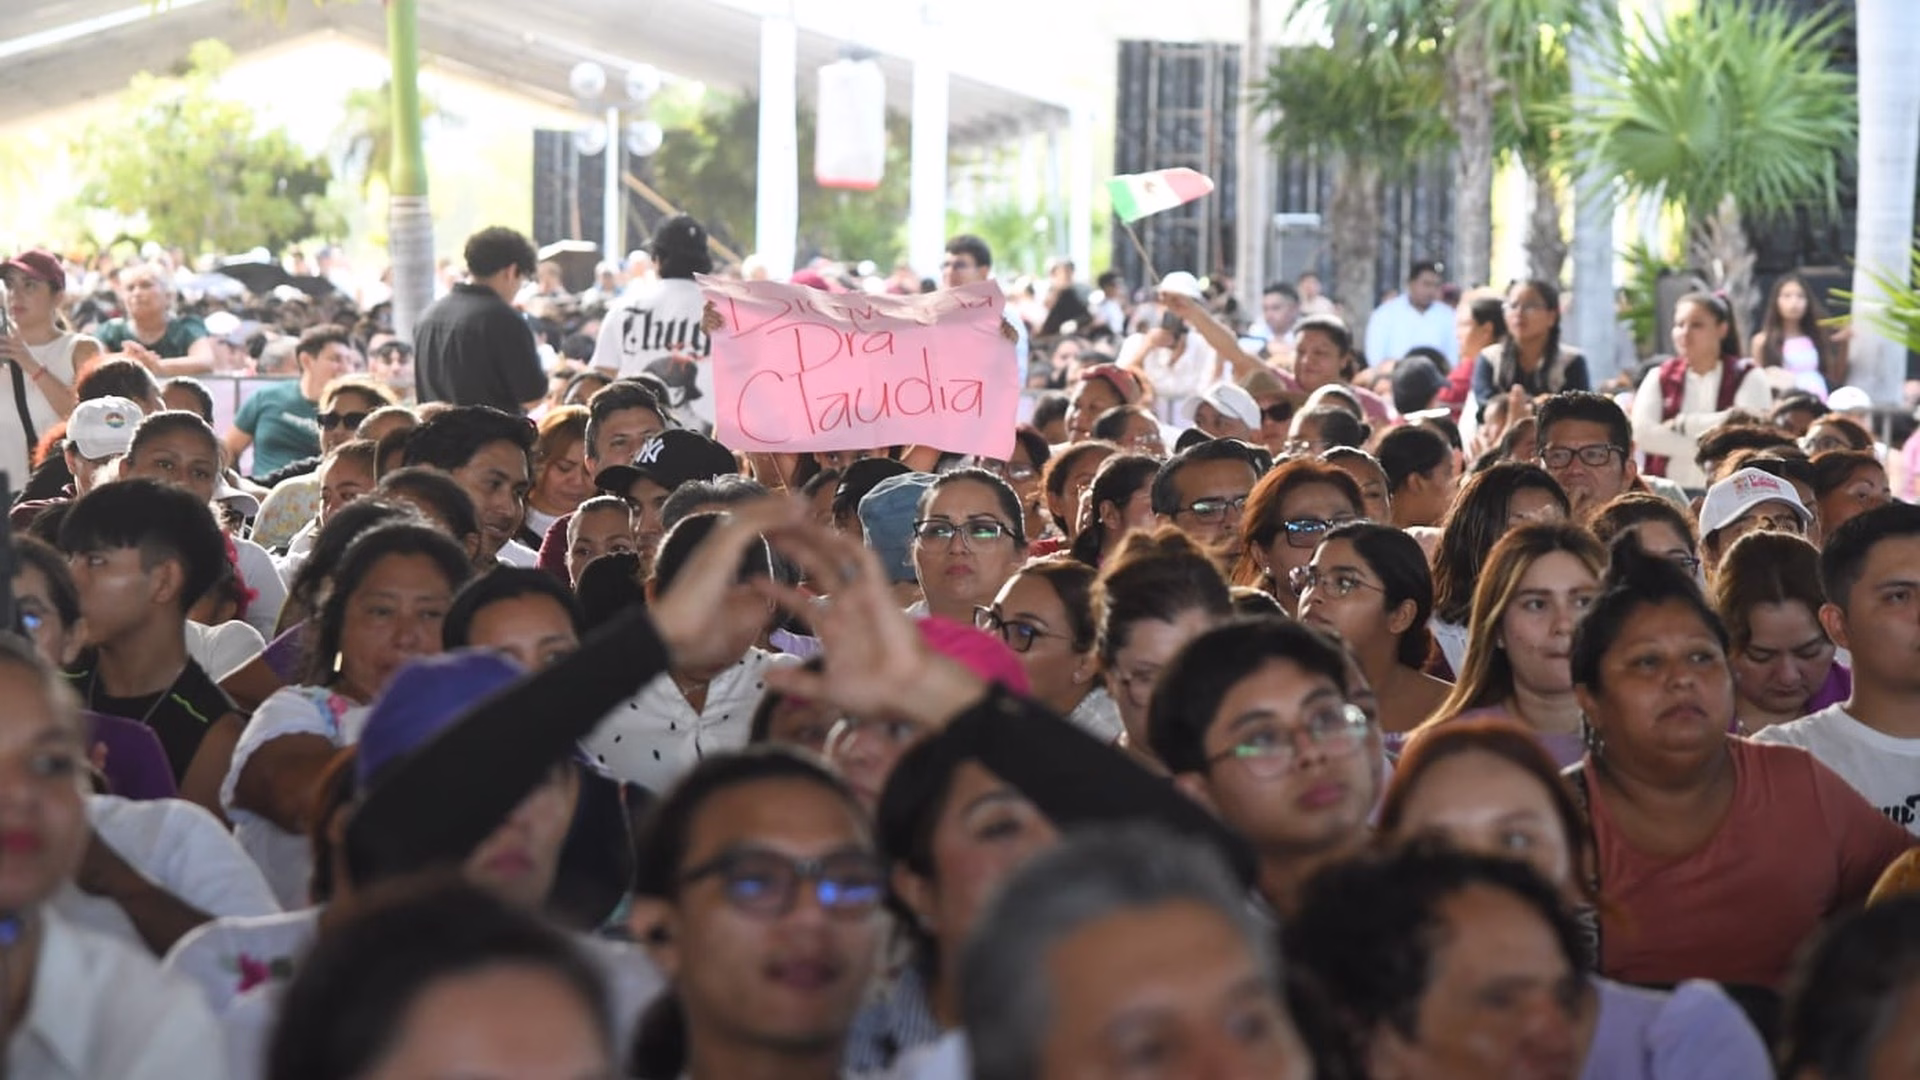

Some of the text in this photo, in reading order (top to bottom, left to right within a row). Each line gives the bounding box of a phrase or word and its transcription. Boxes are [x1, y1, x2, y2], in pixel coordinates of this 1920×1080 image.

[623, 306, 711, 357] Thug
[767, 322, 894, 371] Dra
[737, 346, 983, 444] Claudia
[635, 438, 665, 463] NY
